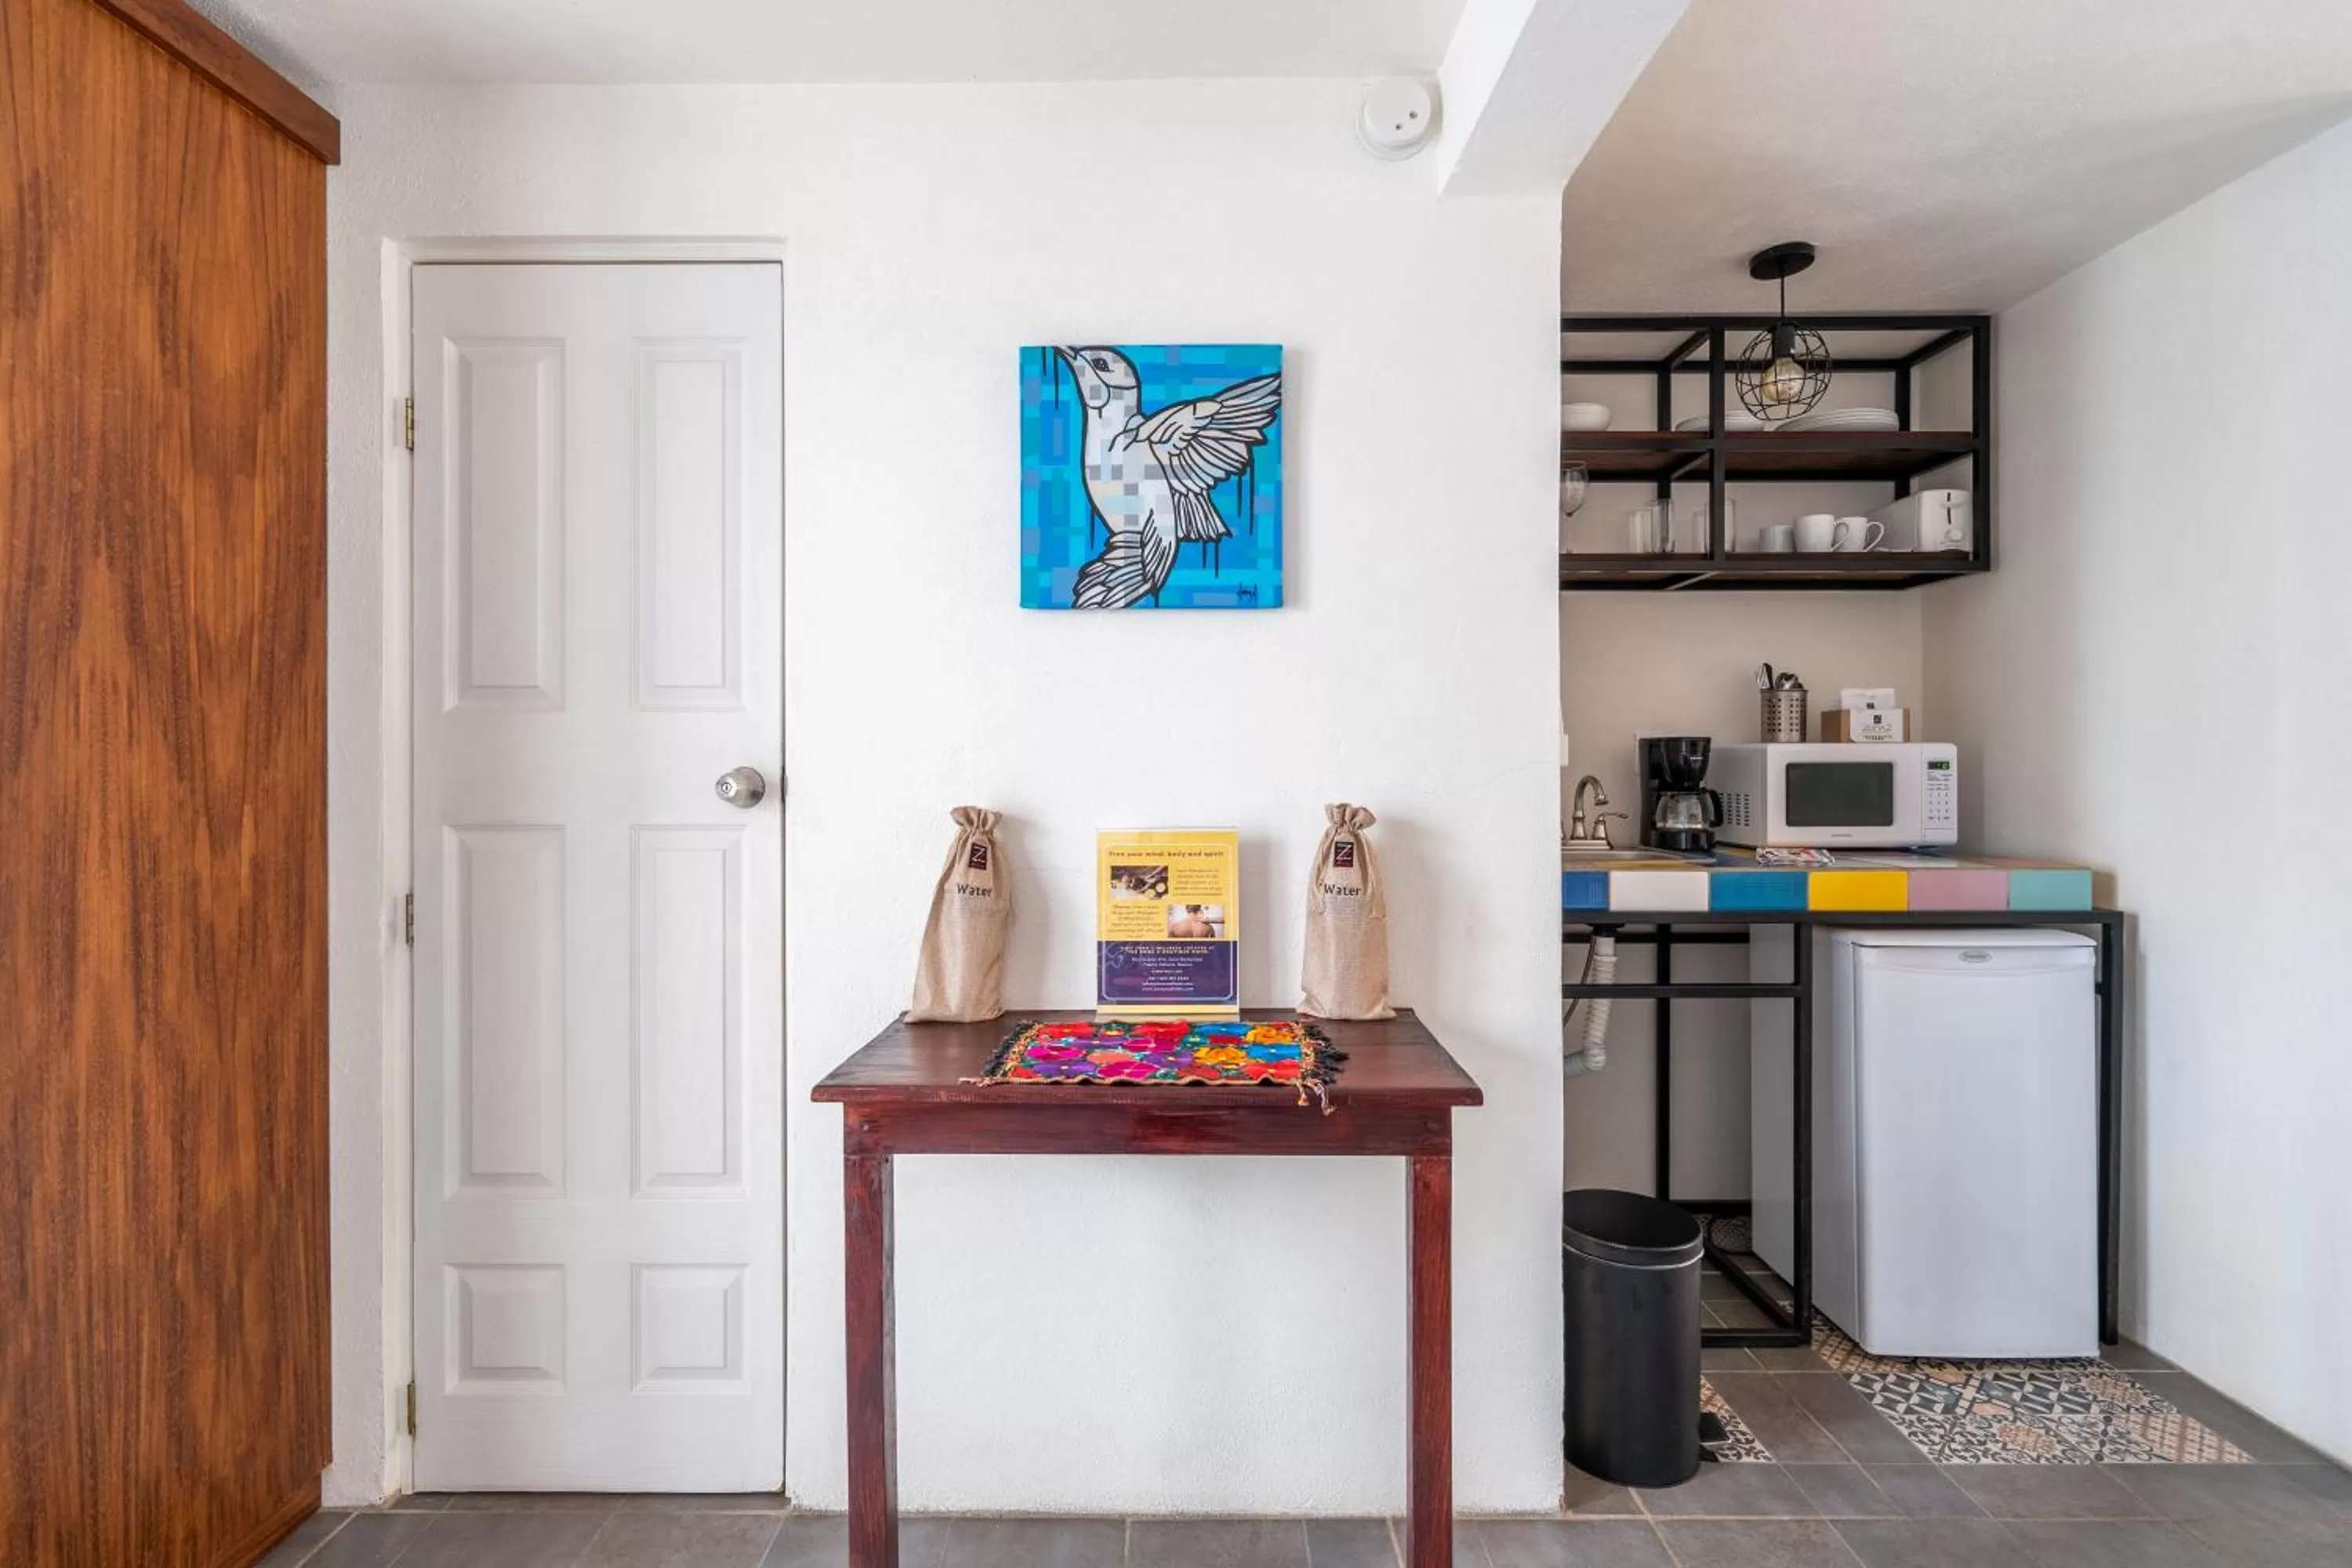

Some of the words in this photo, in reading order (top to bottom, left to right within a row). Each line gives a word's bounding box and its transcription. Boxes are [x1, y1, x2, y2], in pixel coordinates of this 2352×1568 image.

[1335, 843, 1352, 860] Z
[956, 883, 993, 897] Water
[1324, 884, 1362, 896] Water
